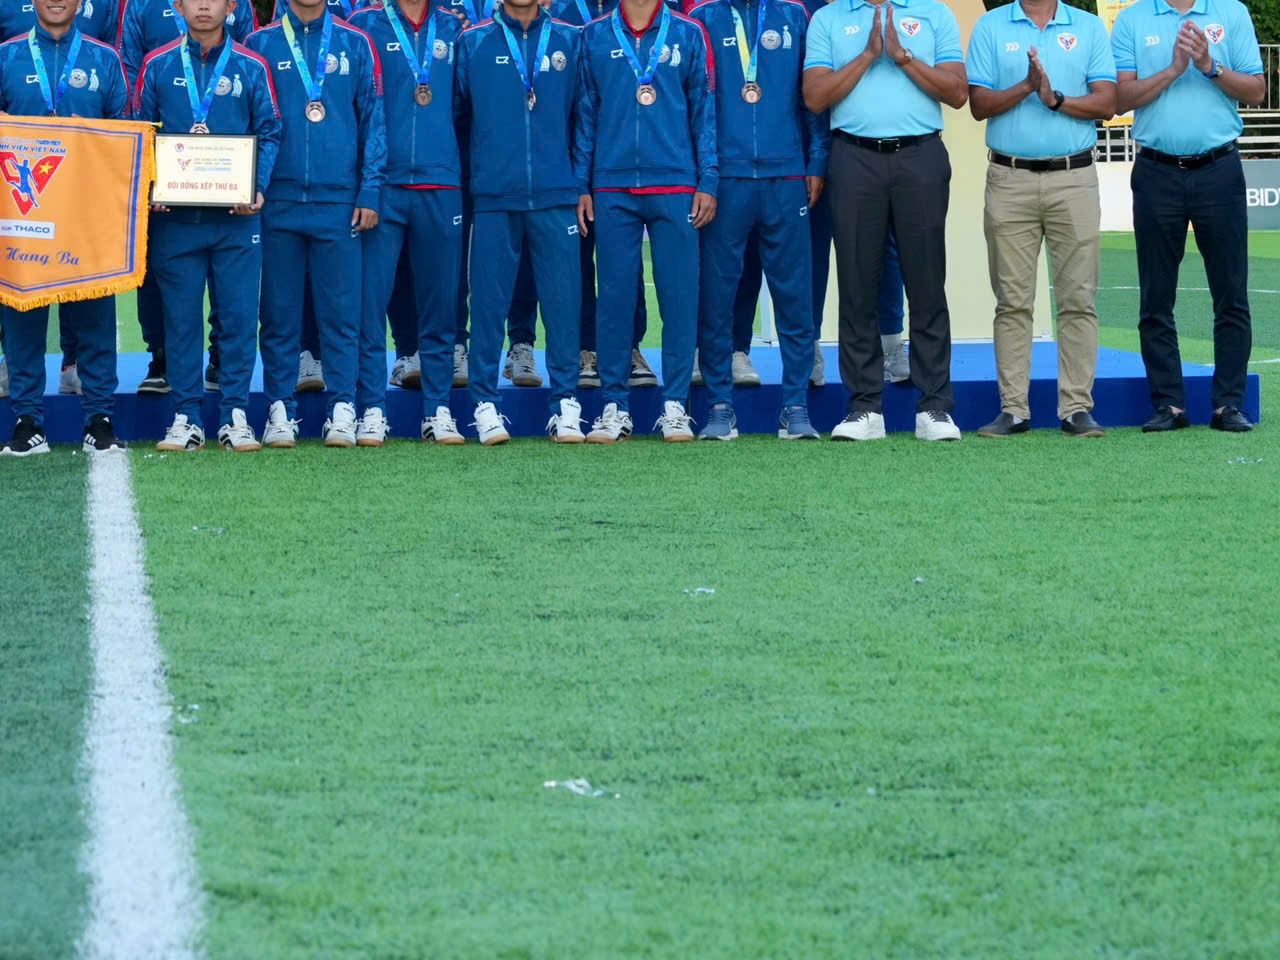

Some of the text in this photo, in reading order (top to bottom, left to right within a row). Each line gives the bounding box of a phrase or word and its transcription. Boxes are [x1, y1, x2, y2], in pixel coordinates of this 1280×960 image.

[1246, 188, 1280, 206] BID
[14, 224, 50, 234] THACO
[56, 250, 80, 265] Ba
